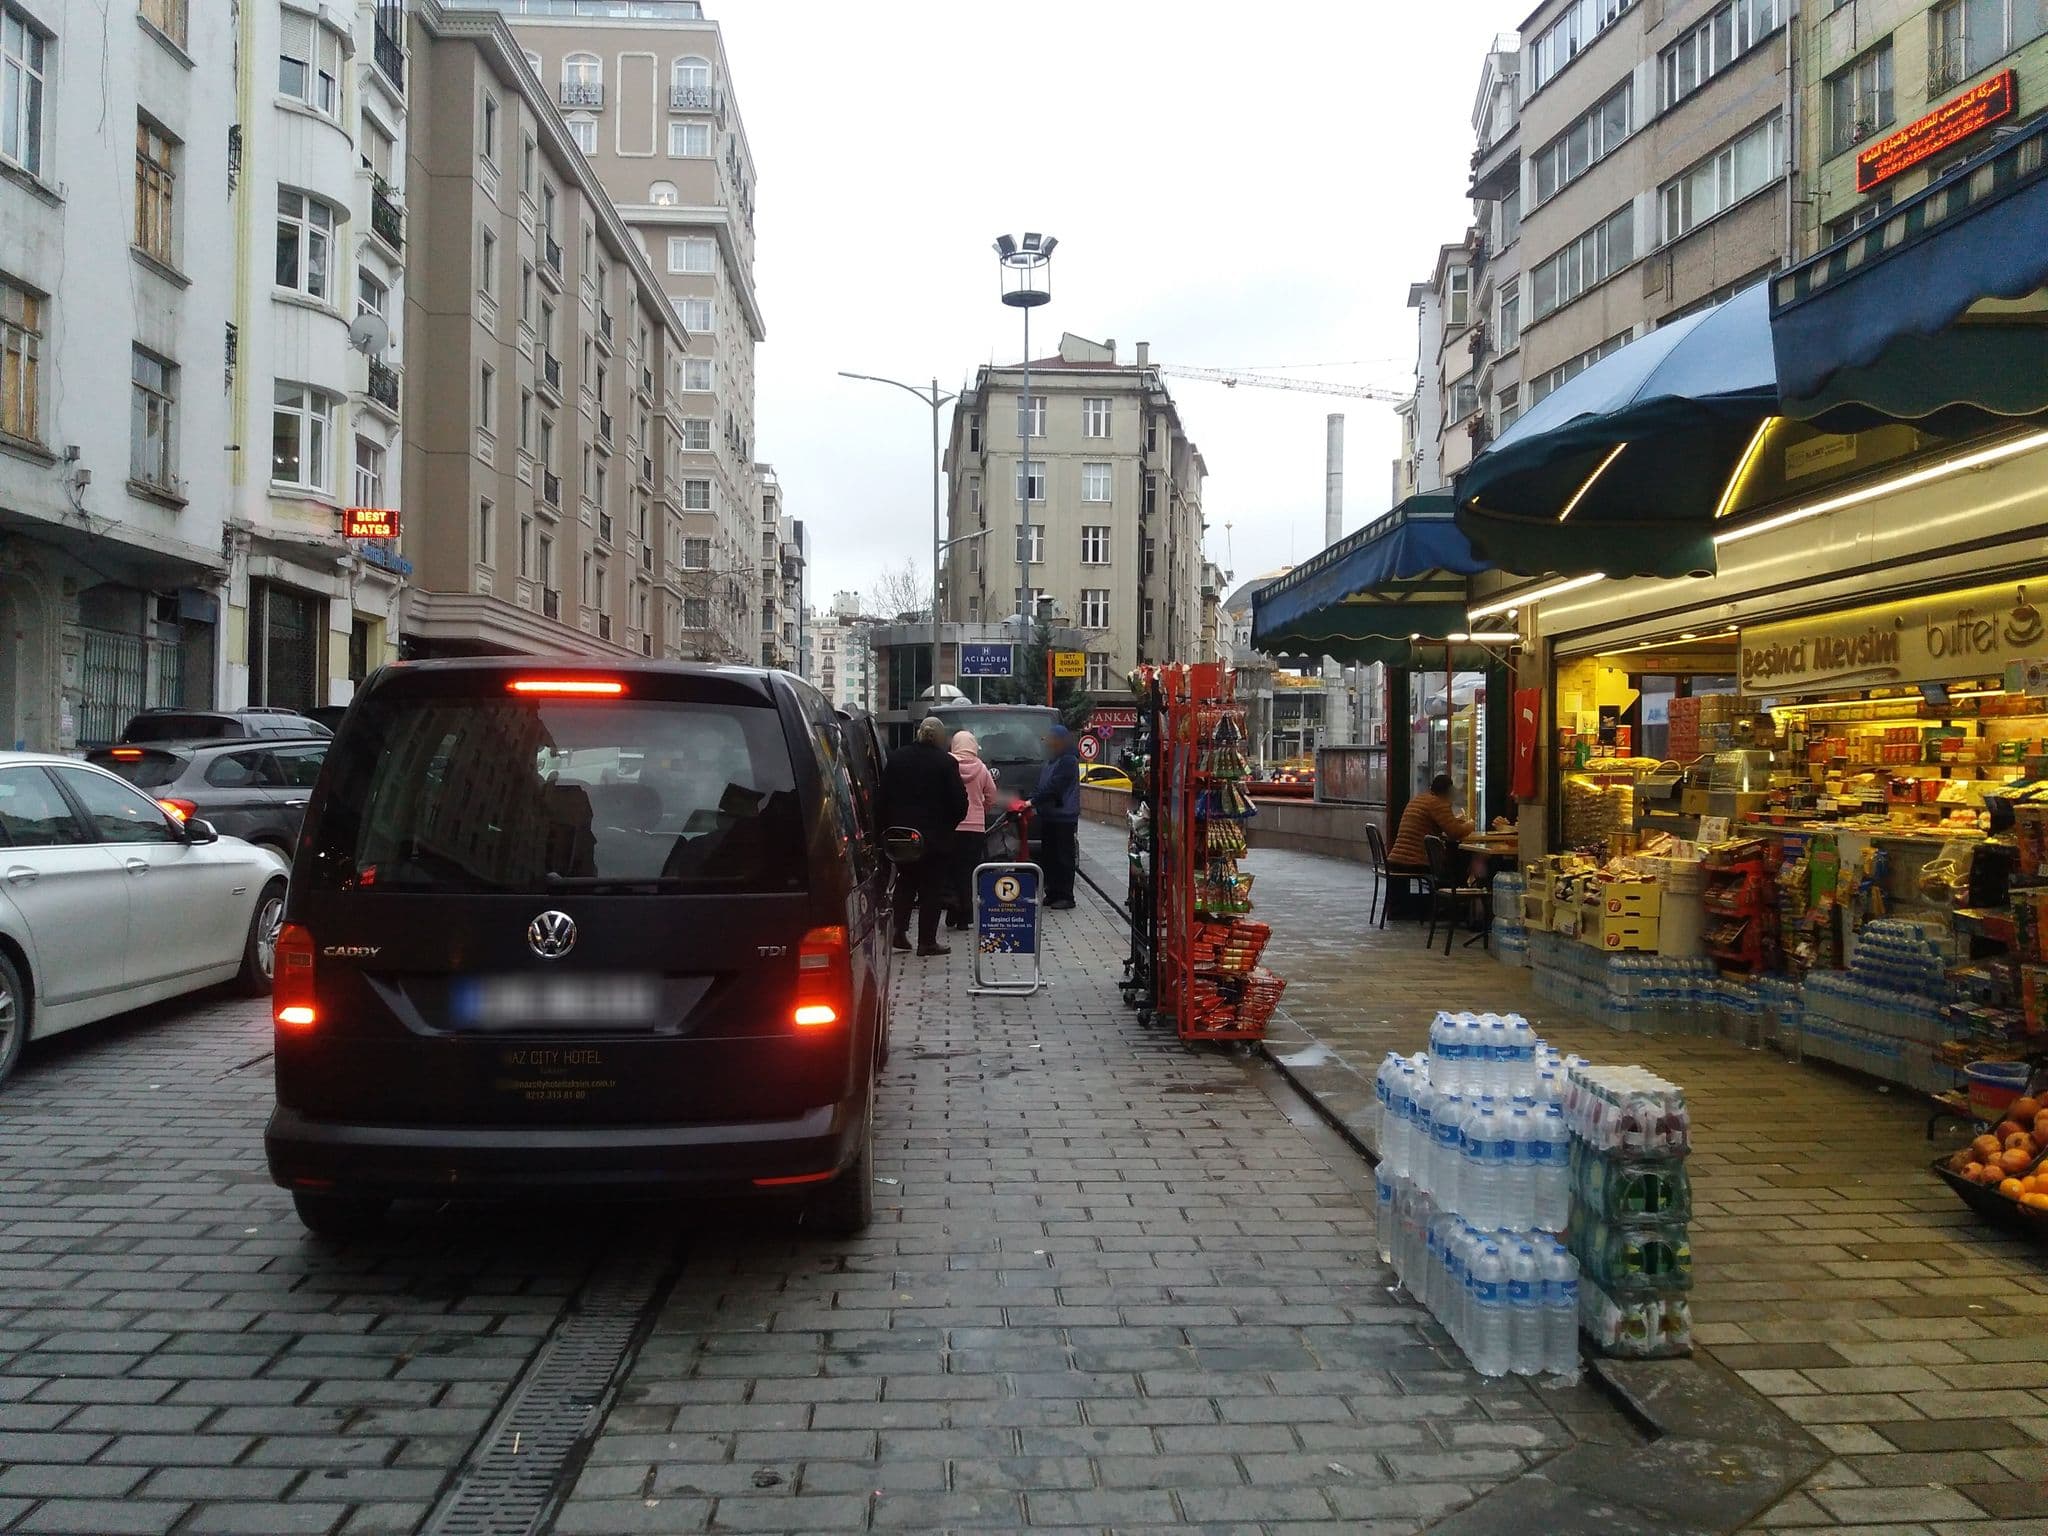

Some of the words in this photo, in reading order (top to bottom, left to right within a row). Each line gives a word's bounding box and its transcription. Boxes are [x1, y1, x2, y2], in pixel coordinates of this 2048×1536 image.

[356, 511, 387, 522] BEST
[352, 523, 390, 535] RATES
[964, 655, 1008, 663] ACIBADEM
[1092, 712, 1138, 722] ANKAS
[323, 945, 382, 957] CADDY
[757, 945, 787, 957] TDI
[530, 1050, 560, 1065] CITY
[564, 1050, 603, 1065] HOTEL
